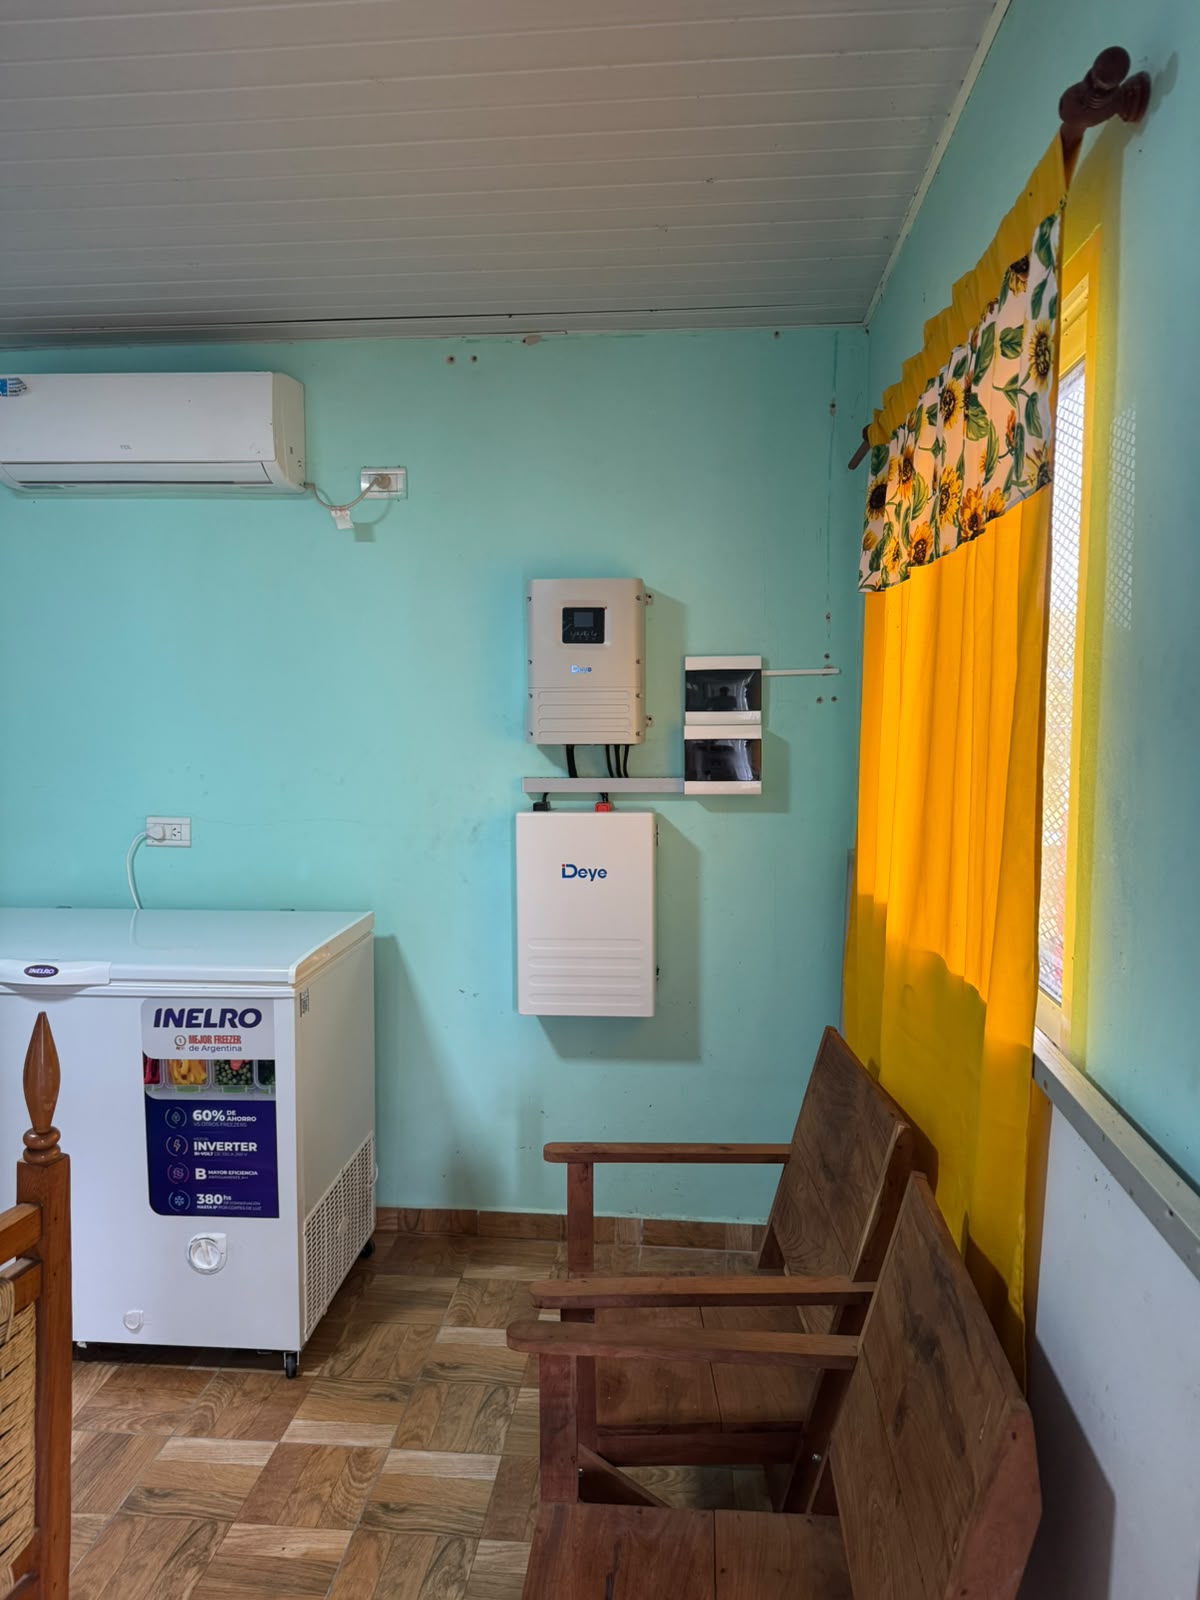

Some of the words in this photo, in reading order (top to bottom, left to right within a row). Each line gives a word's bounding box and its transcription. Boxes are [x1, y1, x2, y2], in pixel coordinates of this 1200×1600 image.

[561, 863, 608, 882] Deye
[27, 967, 55, 975] INELRO
[153, 1007, 263, 1029] INELRO
[188, 1034, 213, 1045] MEJOR
[214, 1034, 242, 1045] FREEZER
[201, 1045, 242, 1053] Argentina
[192, 1109, 226, 1122] 60%
[193, 1141, 258, 1152] INVERTER
[195, 1168, 207, 1180] B
[196, 1194, 223, 1205] 380
